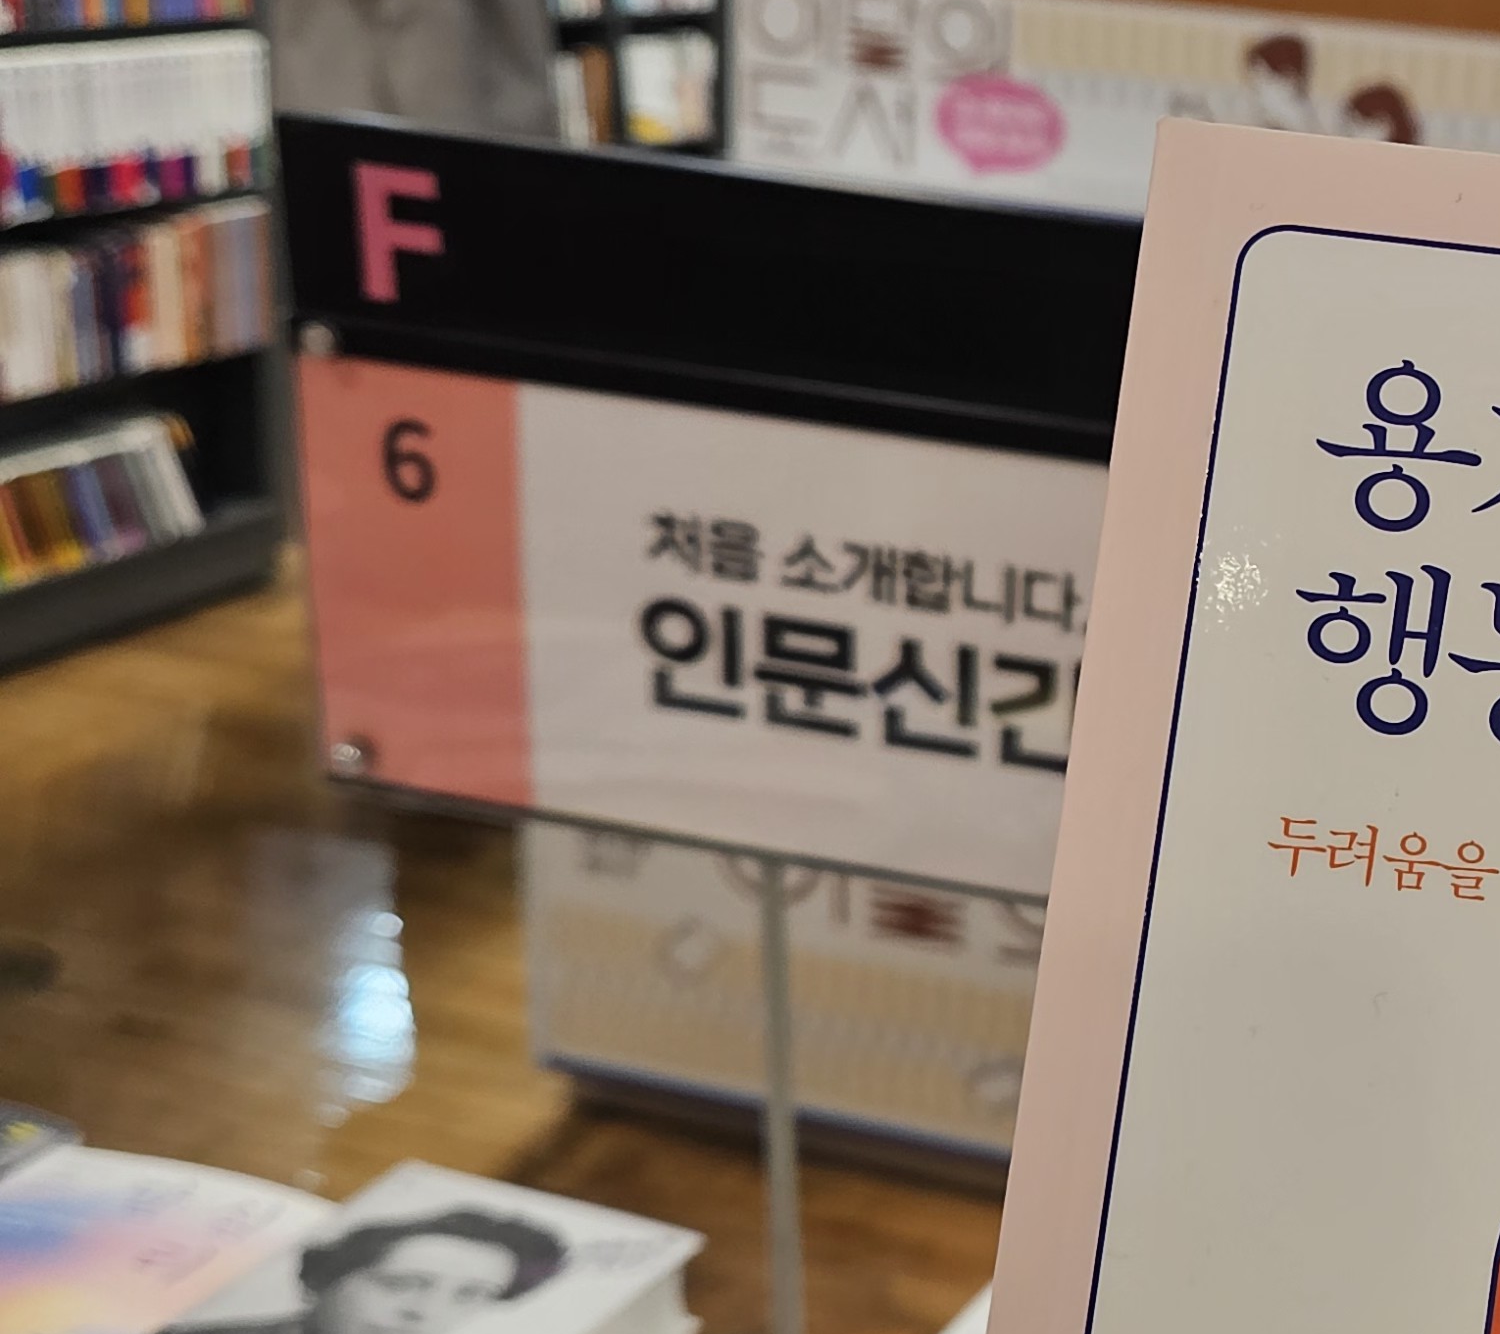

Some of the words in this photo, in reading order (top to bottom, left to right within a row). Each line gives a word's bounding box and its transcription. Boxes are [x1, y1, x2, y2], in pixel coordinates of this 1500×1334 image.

[352, 162, 444, 303] F
[379, 419, 437, 501] 6
[1267, 817, 1500, 893] 두려움을
